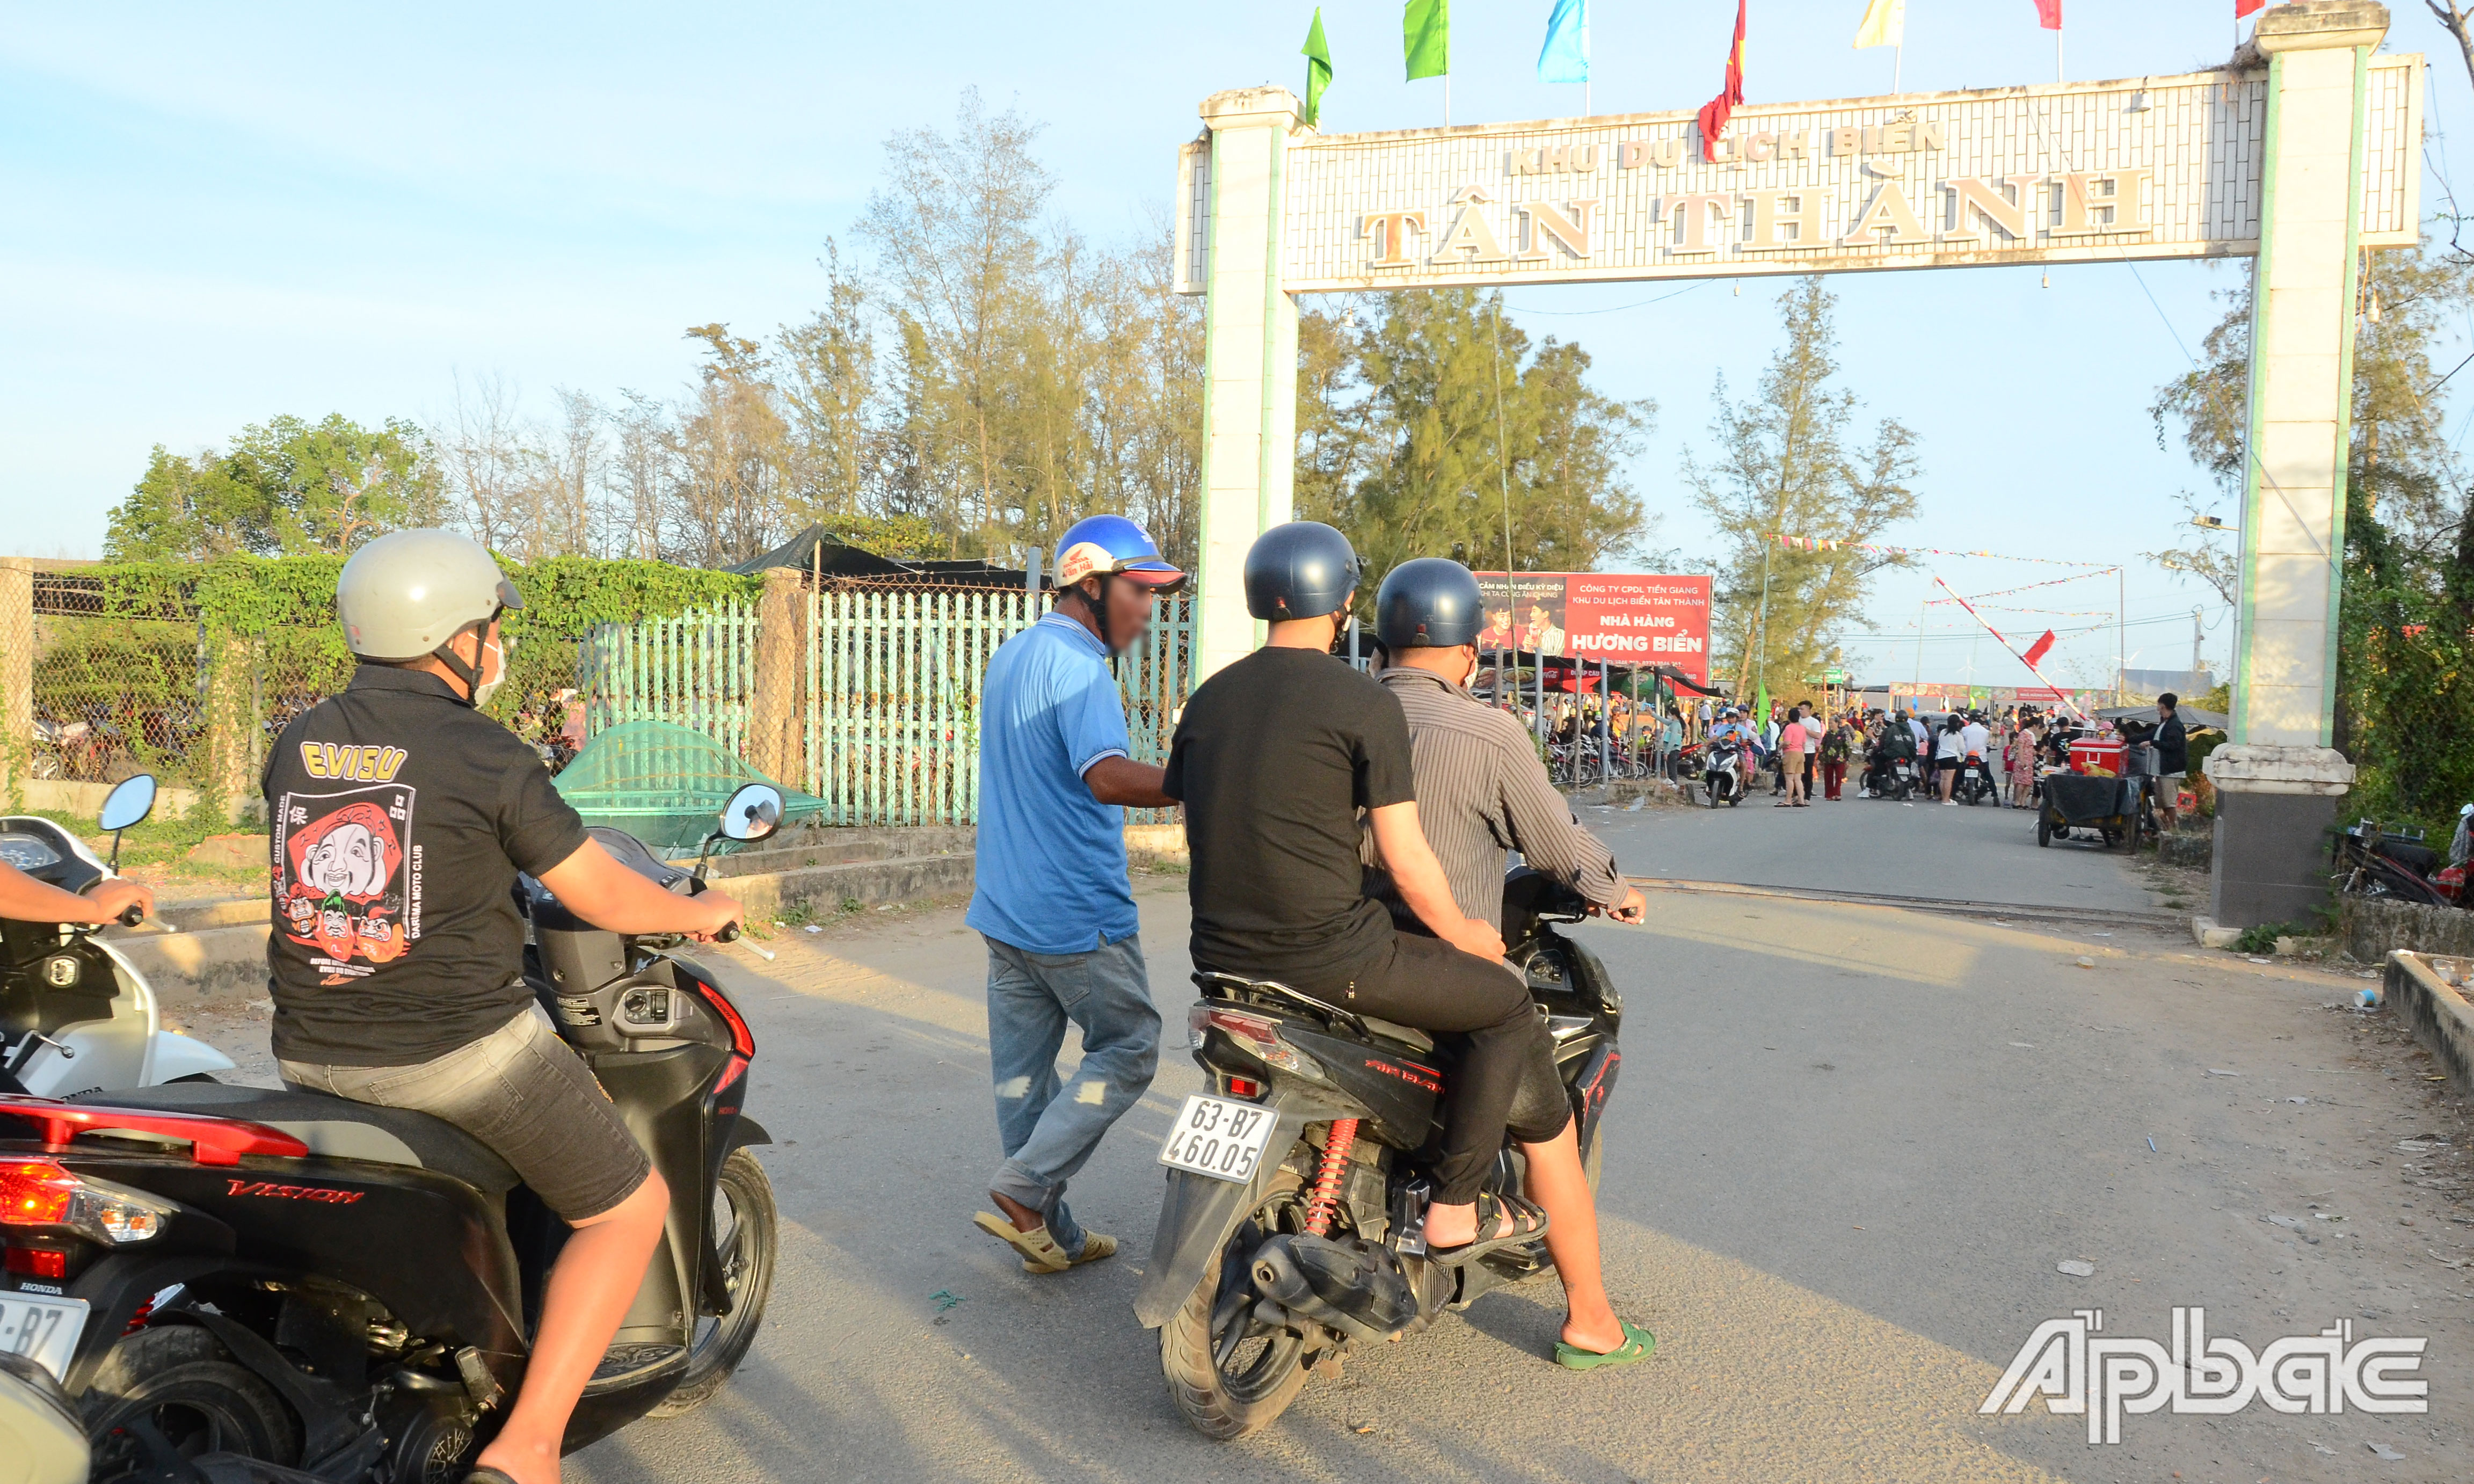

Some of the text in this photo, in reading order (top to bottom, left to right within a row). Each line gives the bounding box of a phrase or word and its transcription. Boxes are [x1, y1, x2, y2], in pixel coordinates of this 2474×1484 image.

[1510, 144, 1599, 176] KHU
[1622, 138, 1683, 169] DU
[1832, 106, 1945, 157] BIỂN
[1360, 158, 2152, 268] TÂN THÀNH
[1063, 557, 1089, 569] HONDA
[1479, 581, 1495, 590] CẢM
[1547, 583, 1564, 591] DIỆU
[1580, 584, 1605, 593] CÔNG
[1647, 584, 1667, 594] TIỀN
[1669, 586, 1698, 594] GIANG
[1573, 596, 1591, 604] KHU
[1608, 597, 1629, 606] LỊCH
[1630, 595, 1650, 605] BIỂN
[1653, 596, 1671, 605] TÂN
[1673, 597, 1705, 606] THÀNH
[1600, 613, 1675, 628] NHÀ HÀNG
[1572, 629, 1702, 653] HƯƠNG BIỂN
[300, 741, 408, 782] EVISU
[274, 795, 286, 863] CUSTOM MADE
[411, 845, 423, 939] DARUMA MOTO CLUB
[1190, 1100, 1263, 1140] 63-B7
[1168, 1131, 1258, 1177] 460.05
[227, 1179, 365, 1204] VISION
[20, 1282, 63, 1295] HONDA
